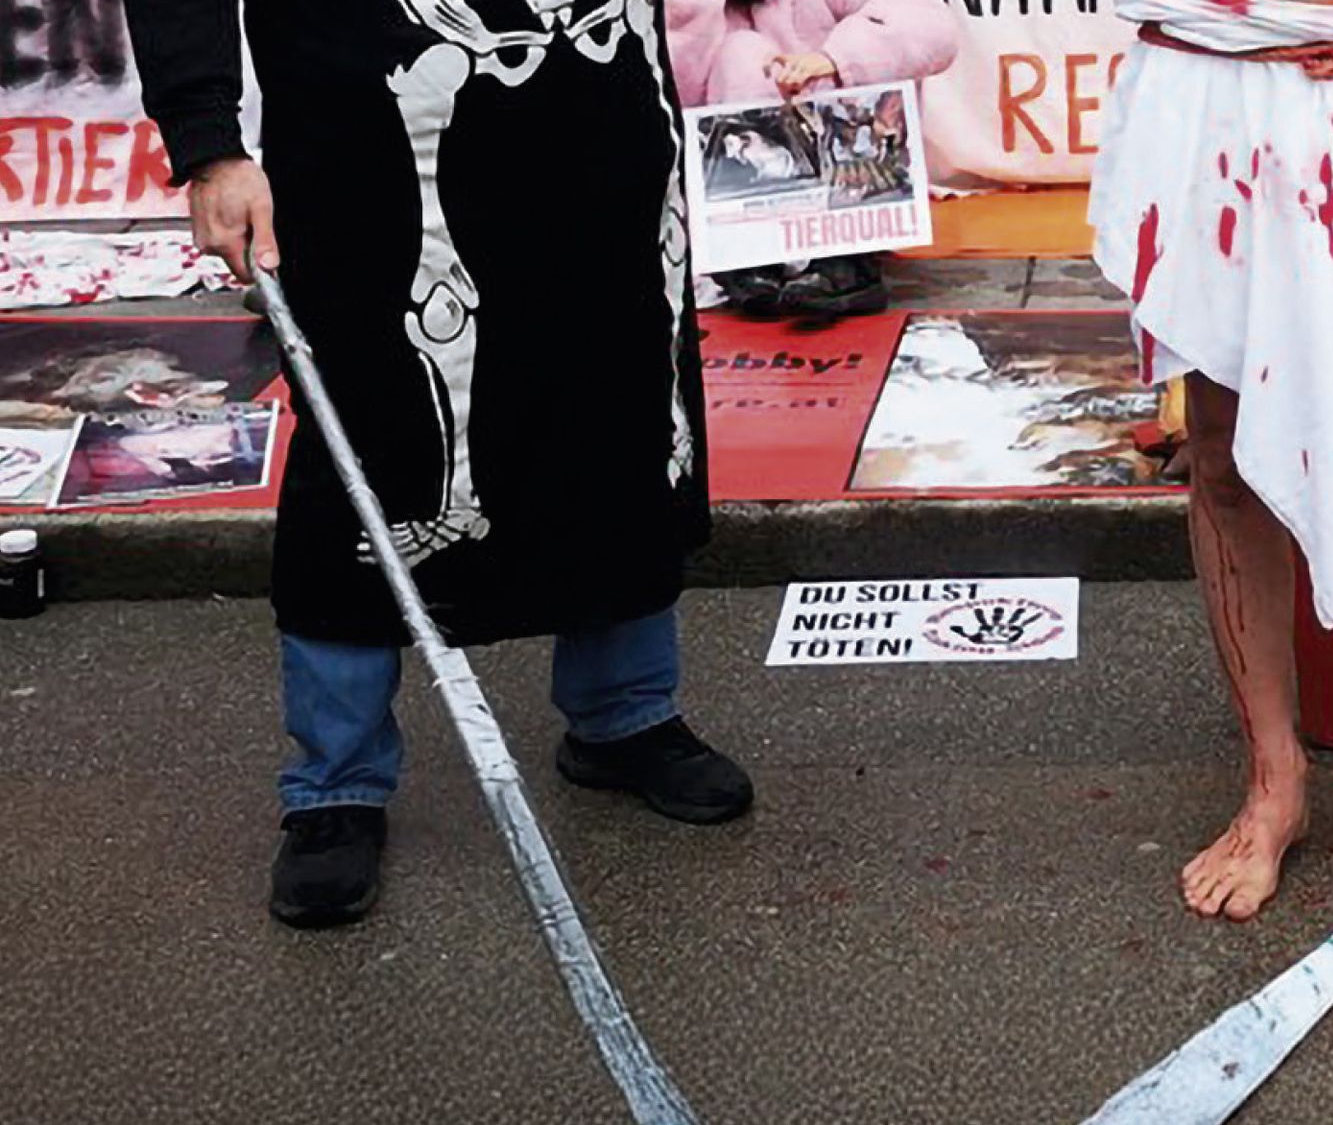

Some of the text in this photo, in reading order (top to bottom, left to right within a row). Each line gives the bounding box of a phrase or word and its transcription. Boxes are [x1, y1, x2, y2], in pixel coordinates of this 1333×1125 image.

[999, 52, 1125, 155] RE
[800, 583, 984, 604] DU SOLLST
[793, 611, 901, 631] NICHT
[788, 637, 913, 658] TÖTEN!
